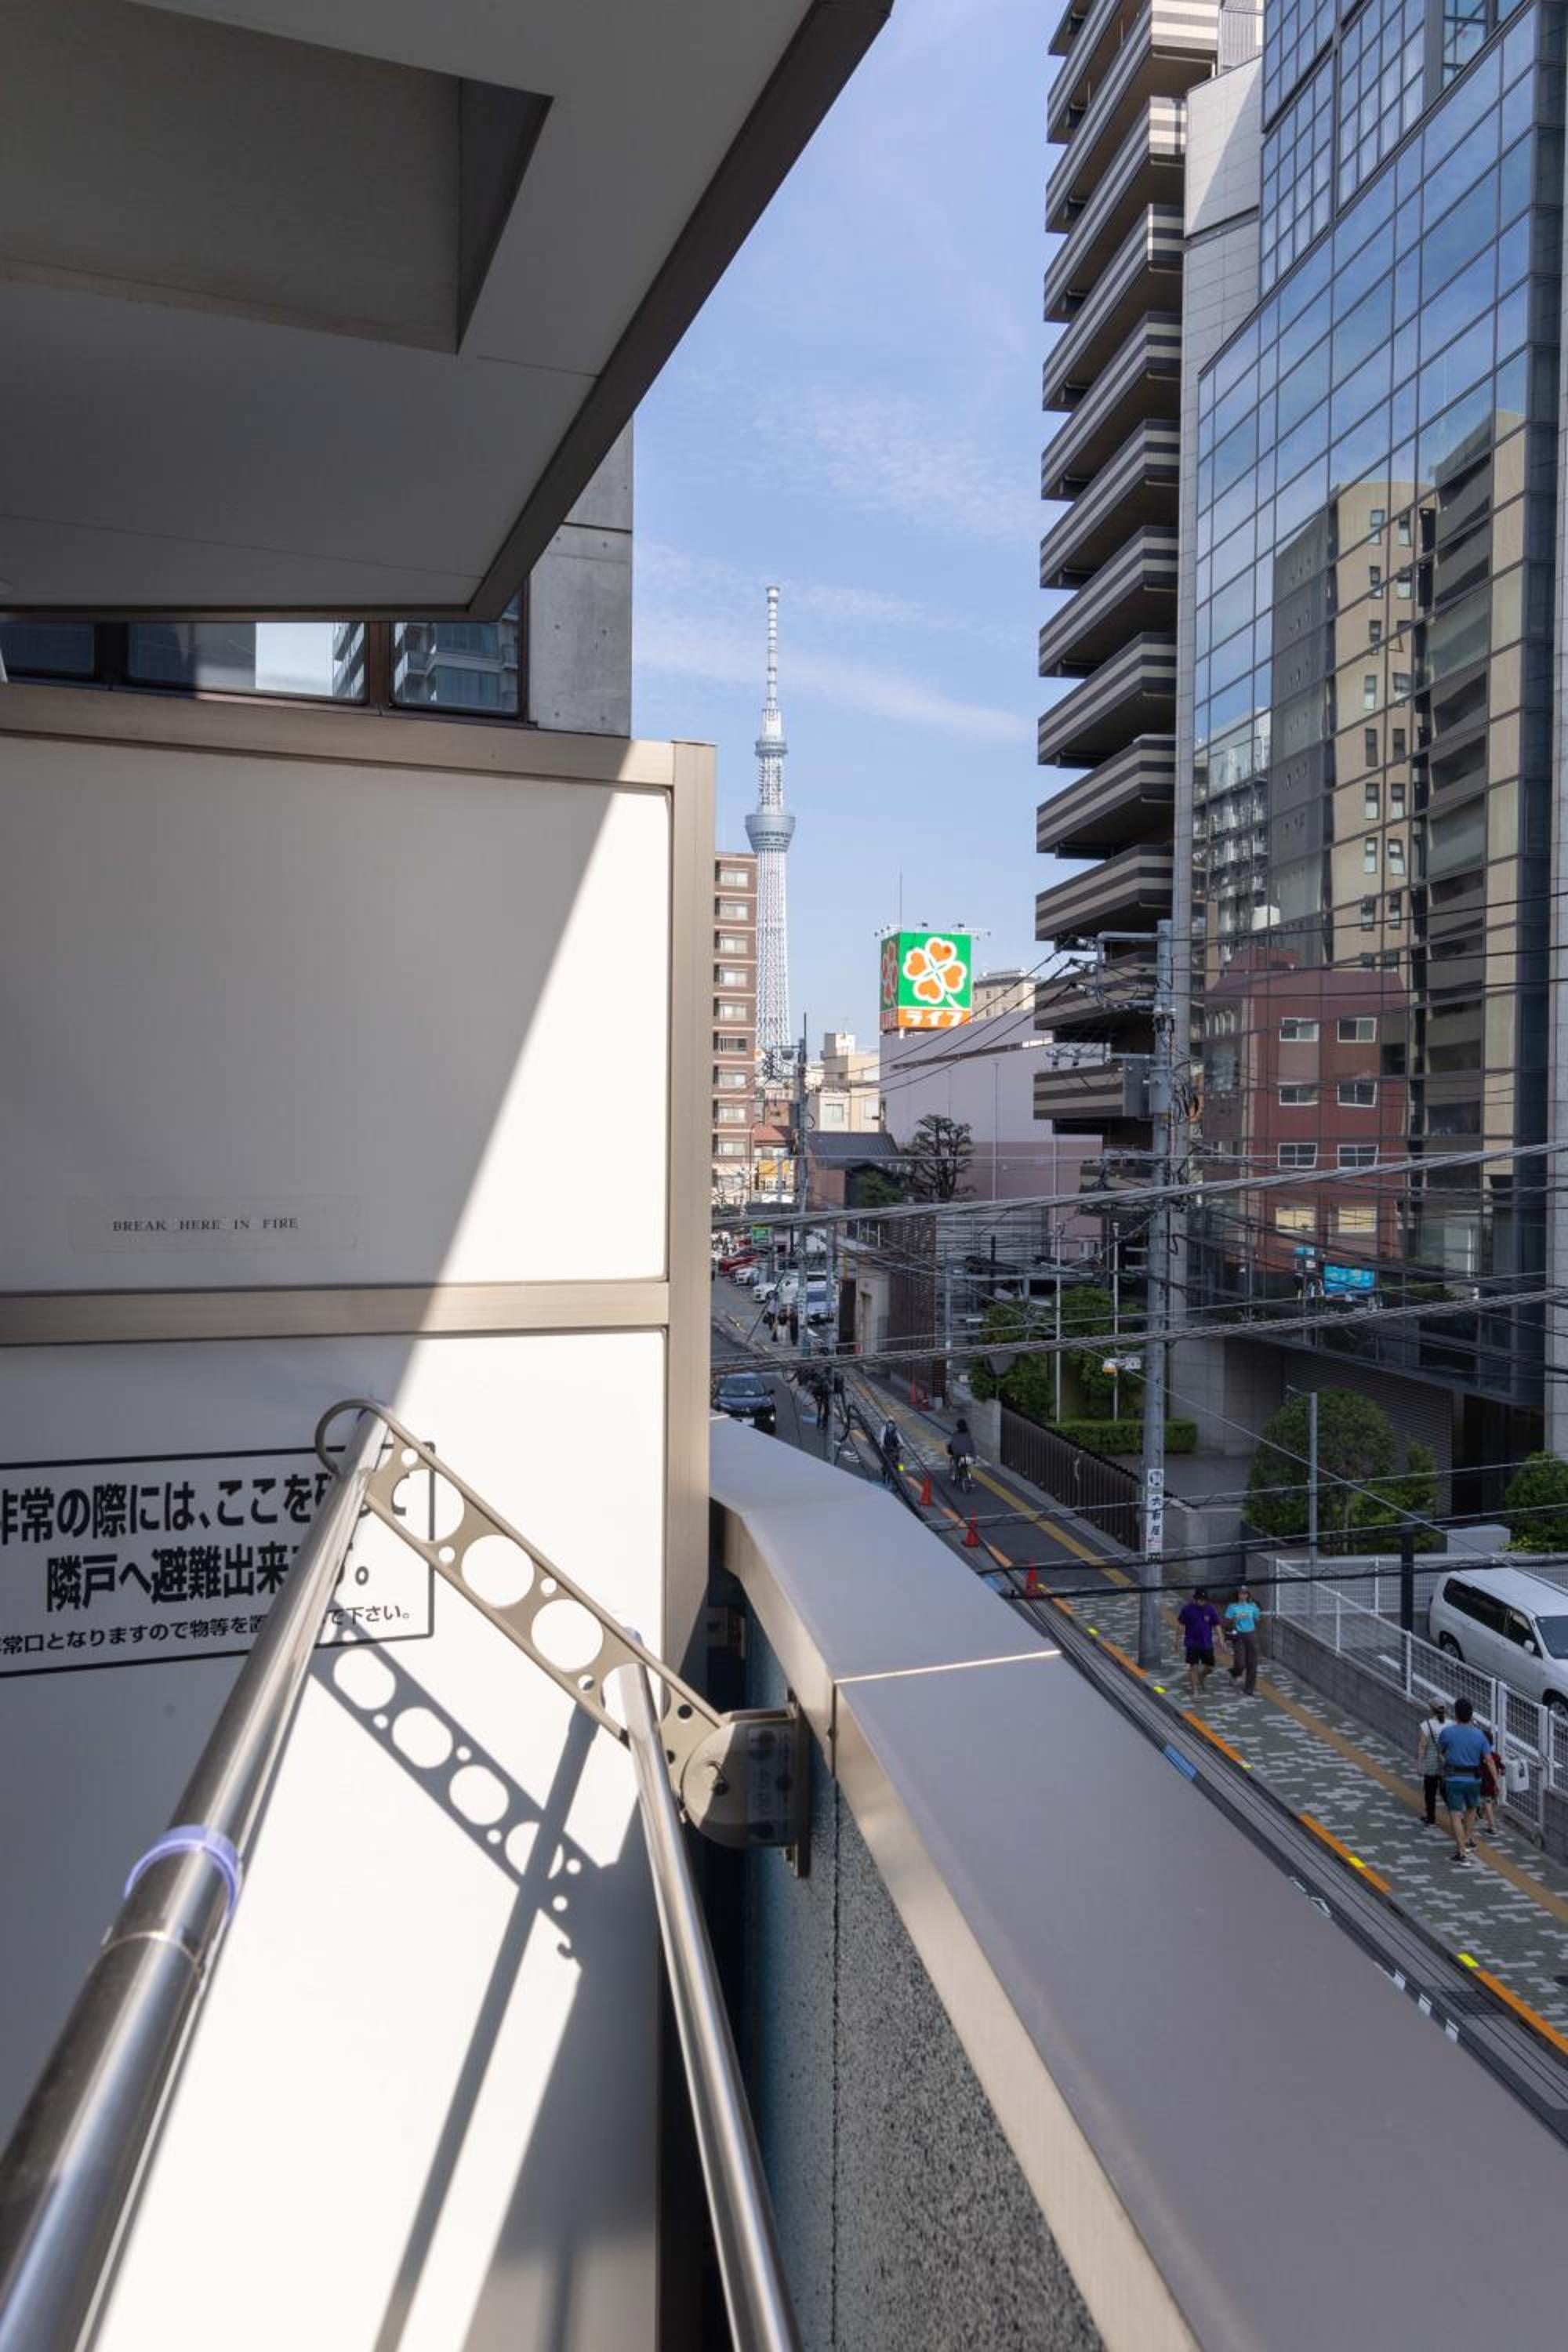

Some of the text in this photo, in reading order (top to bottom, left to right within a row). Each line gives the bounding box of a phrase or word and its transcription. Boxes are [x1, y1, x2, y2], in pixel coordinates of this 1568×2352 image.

[905, 1008, 963, 1028] ライフ
[112, 1217, 299, 1232] BREAK HERE IN FIRE
